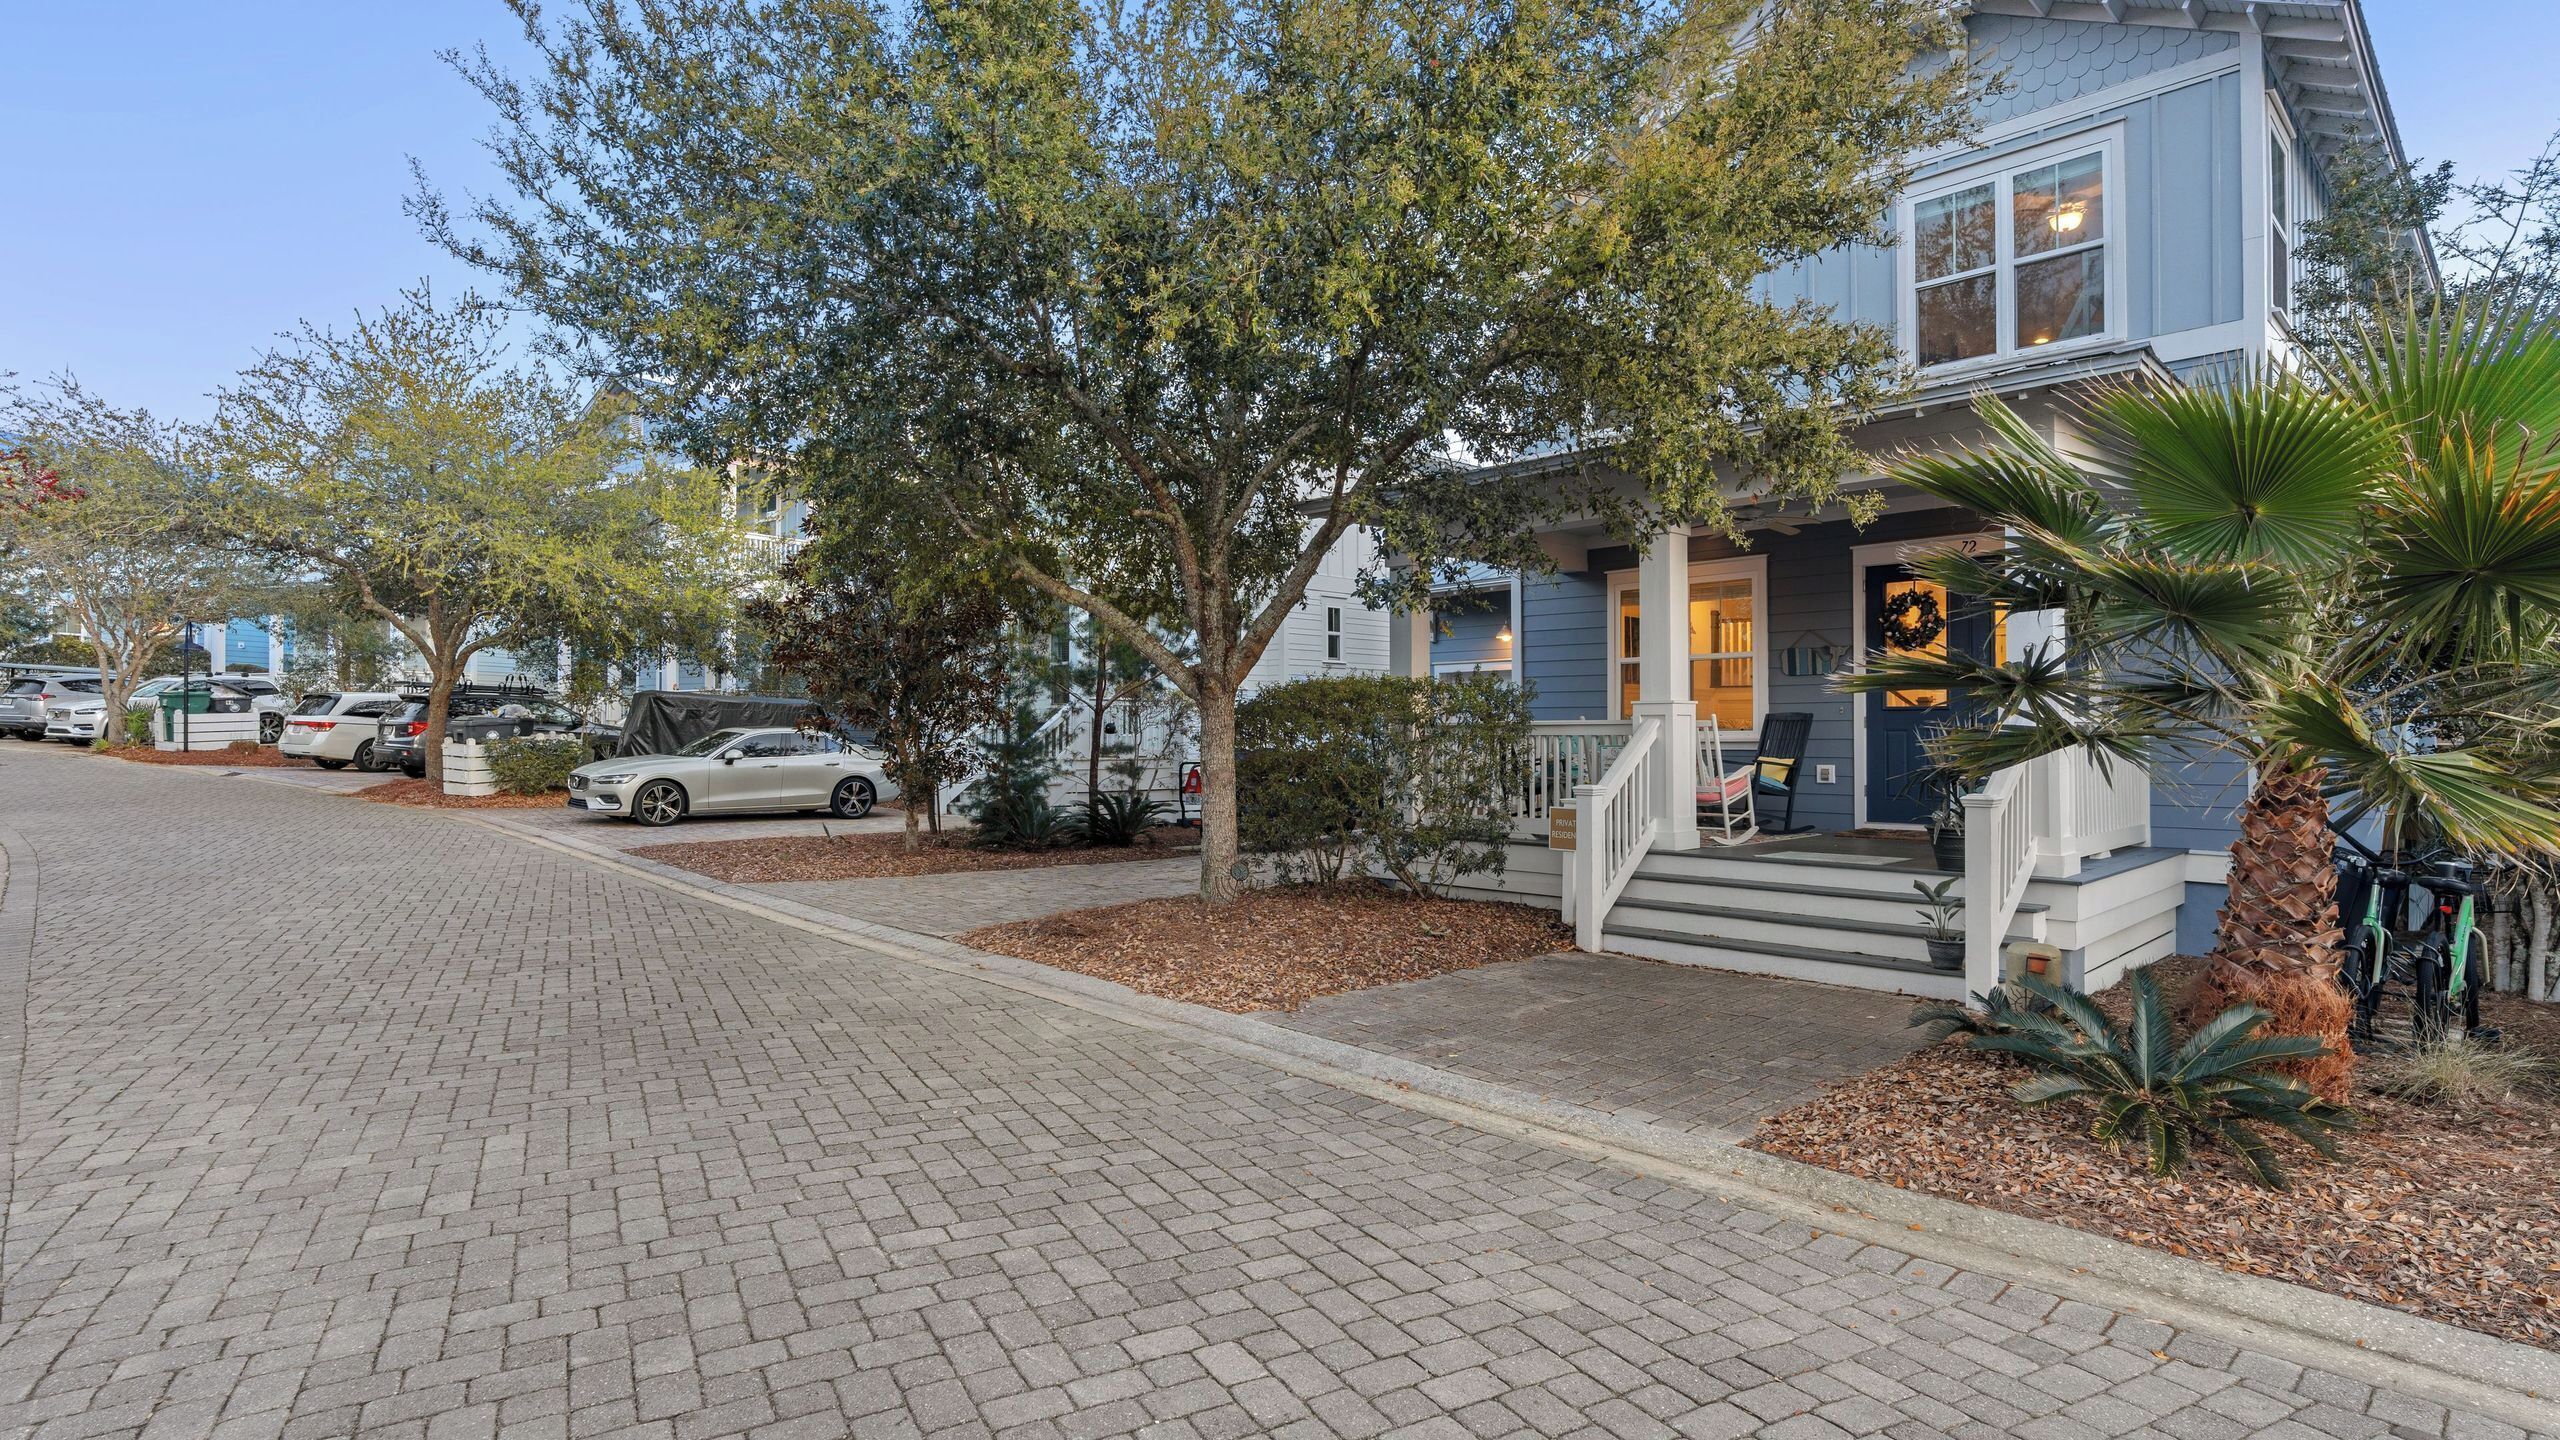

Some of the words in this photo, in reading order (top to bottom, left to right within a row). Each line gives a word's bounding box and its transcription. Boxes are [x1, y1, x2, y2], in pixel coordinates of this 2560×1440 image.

[1960, 539, 1977, 553] 72
[1555, 818, 1576, 827] PRIVAT
[1551, 830, 1576, 839] RESIDEN
